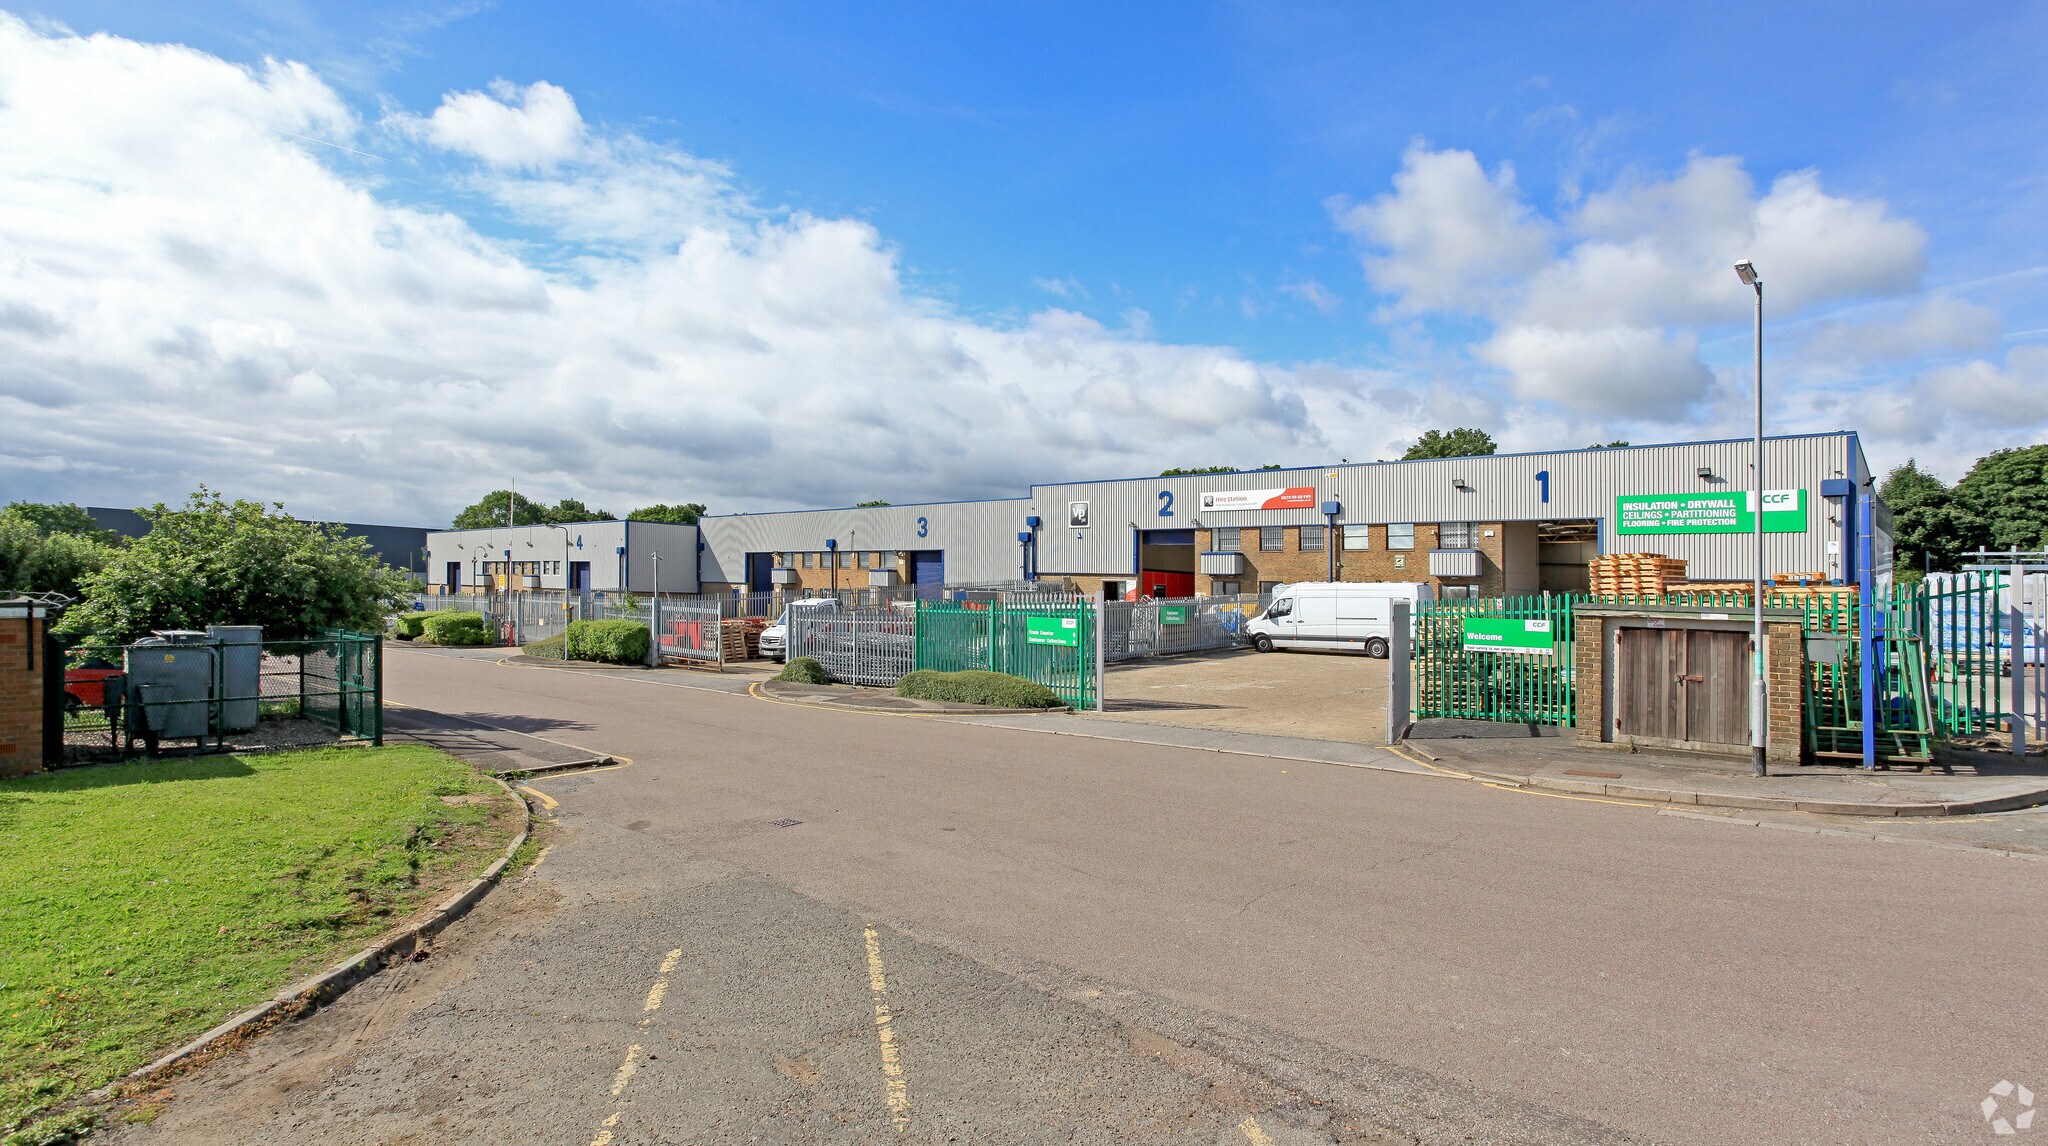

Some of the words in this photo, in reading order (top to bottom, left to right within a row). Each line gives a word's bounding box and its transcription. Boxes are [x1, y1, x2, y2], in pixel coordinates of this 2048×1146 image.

[1535, 470, 1549, 504] 1
[1158, 490, 1174, 517] 2
[1762, 494, 1789, 503] CCF
[1623, 501, 1678, 510] INSULATION
[1688, 499, 1736, 508] DRYWALL
[1072, 508, 1085, 520] Vp
[1622, 510, 1663, 520] CEILINGS
[1671, 509, 1736, 518] PARTITIONING
[917, 516, 928, 538] 3
[1622, 519, 1660, 528] FLOORING
[1686, 518, 1737, 526] PROTECTION
[576, 534, 584, 551] 4
[1467, 632, 1503, 640] Welcome
